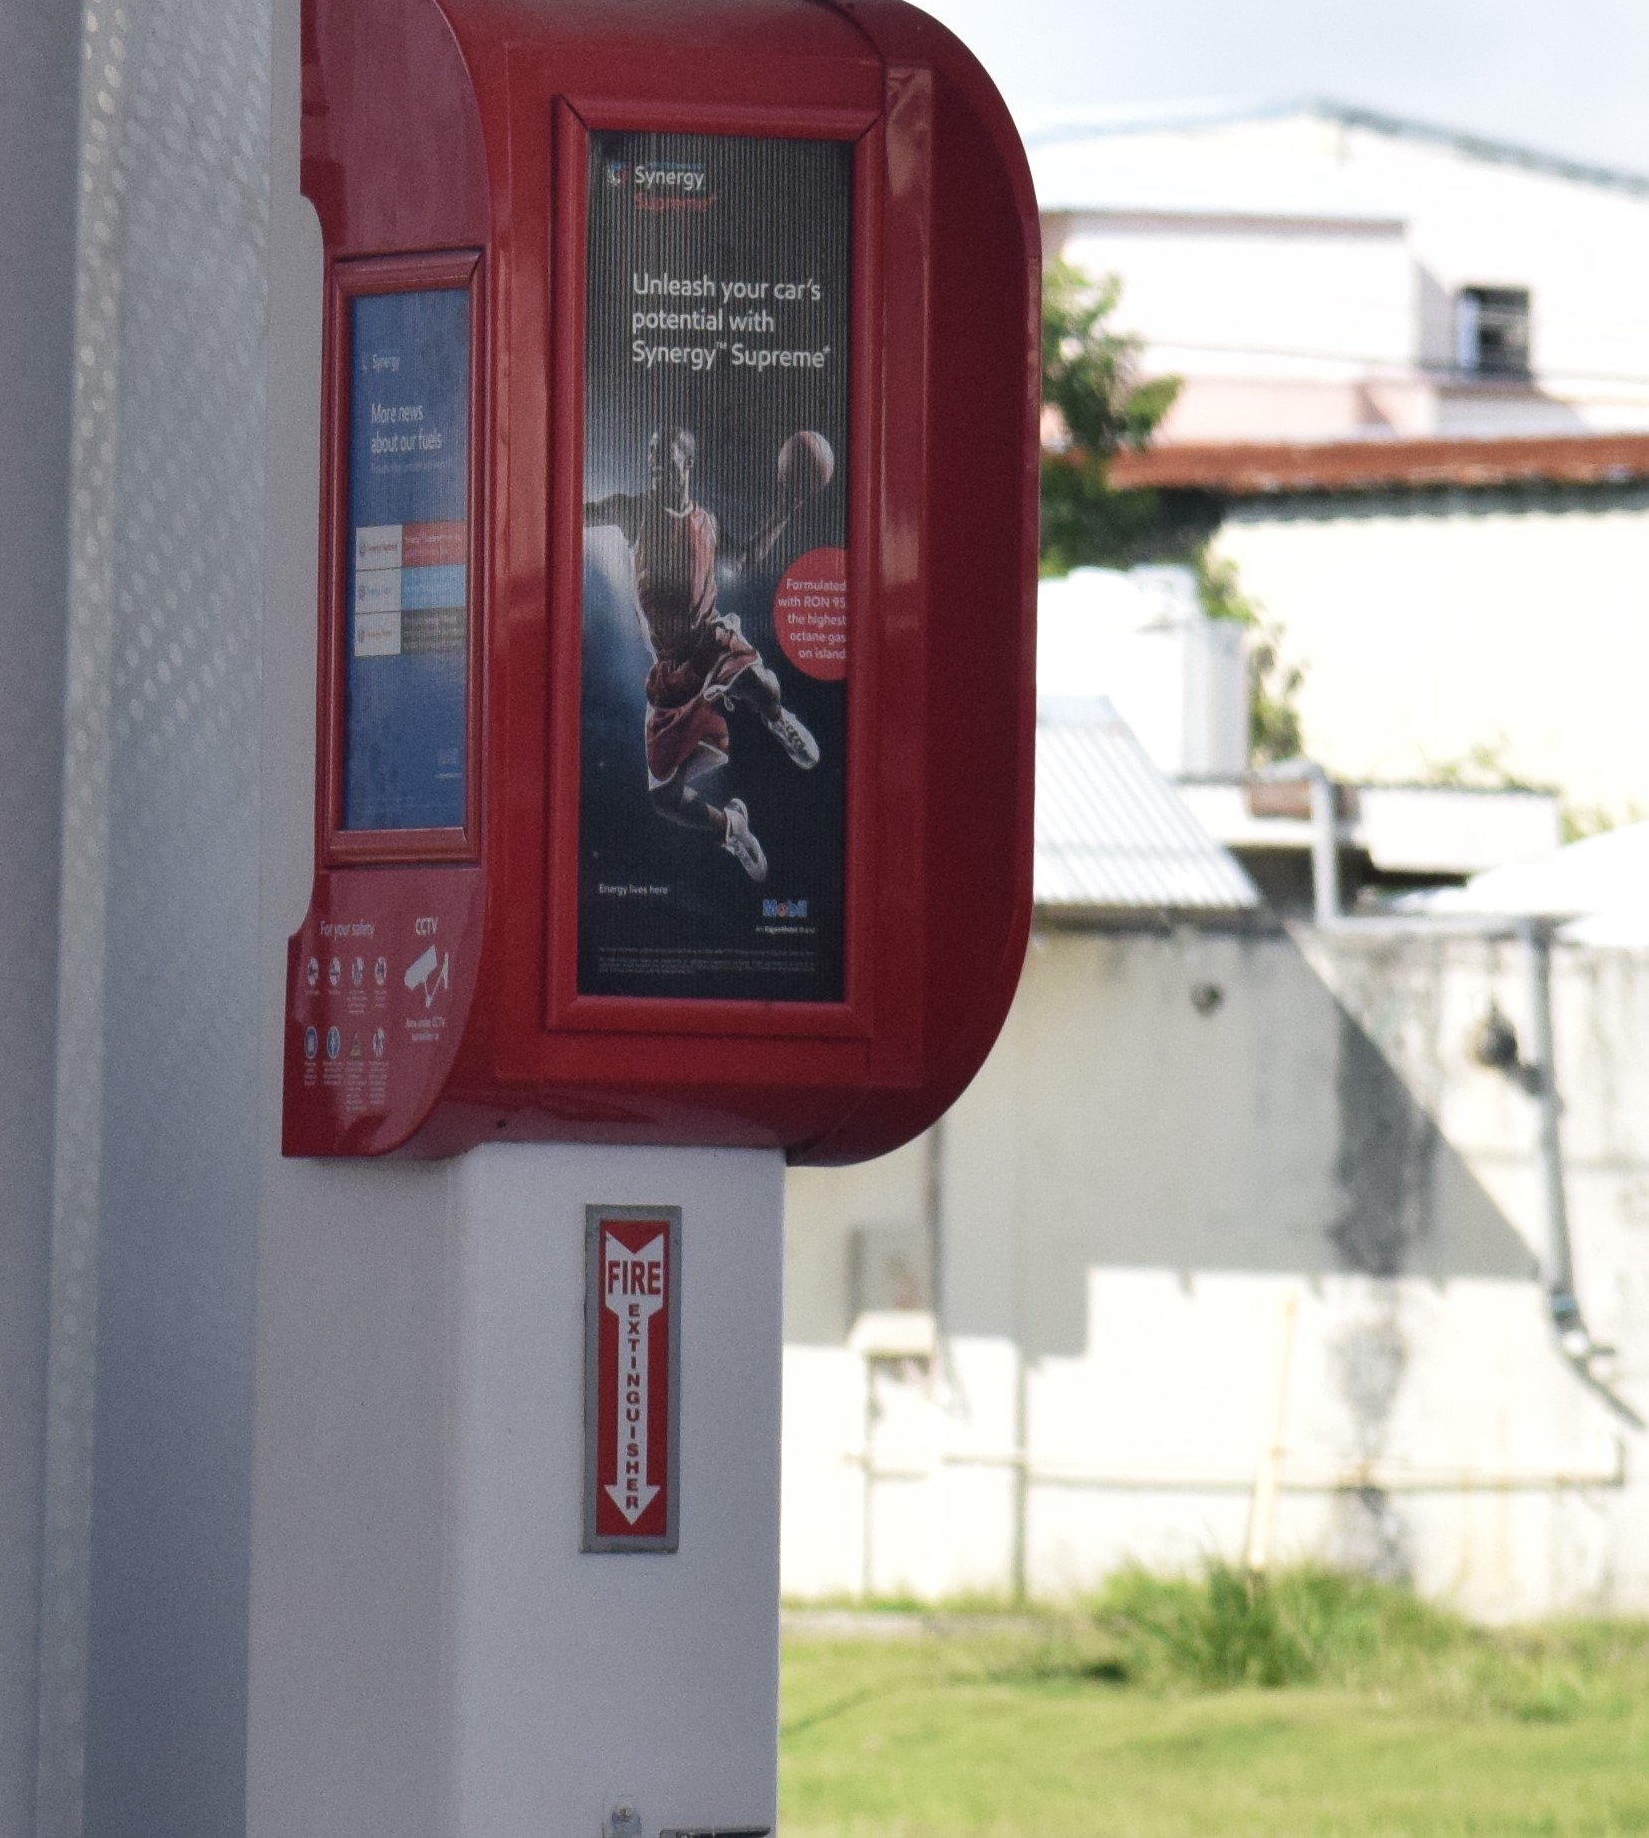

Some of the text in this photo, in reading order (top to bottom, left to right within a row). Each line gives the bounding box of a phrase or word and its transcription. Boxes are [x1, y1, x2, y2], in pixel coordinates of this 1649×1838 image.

[634, 165, 705, 192] Synergy
[633, 272, 821, 304] Unleash your car's
[632, 308, 775, 334] potential with
[371, 403, 424, 424] More news
[371, 428, 443, 454] about our fuels
[786, 578, 847, 592] Formulated
[778, 596, 801, 608] with
[803, 595, 831, 608] RON
[787, 612, 847, 628] the highest
[789, 631, 847, 645] octane gas
[798, 647, 847, 660] on island
[599, 883, 627, 899] Energy
[649, 884, 669, 896] here
[762, 898, 808, 918] Mobil
[415, 917, 439, 937] CCTV
[607, 1260, 662, 1296] FIRE
[625, 1302, 641, 1510] EXTINGUISHER
